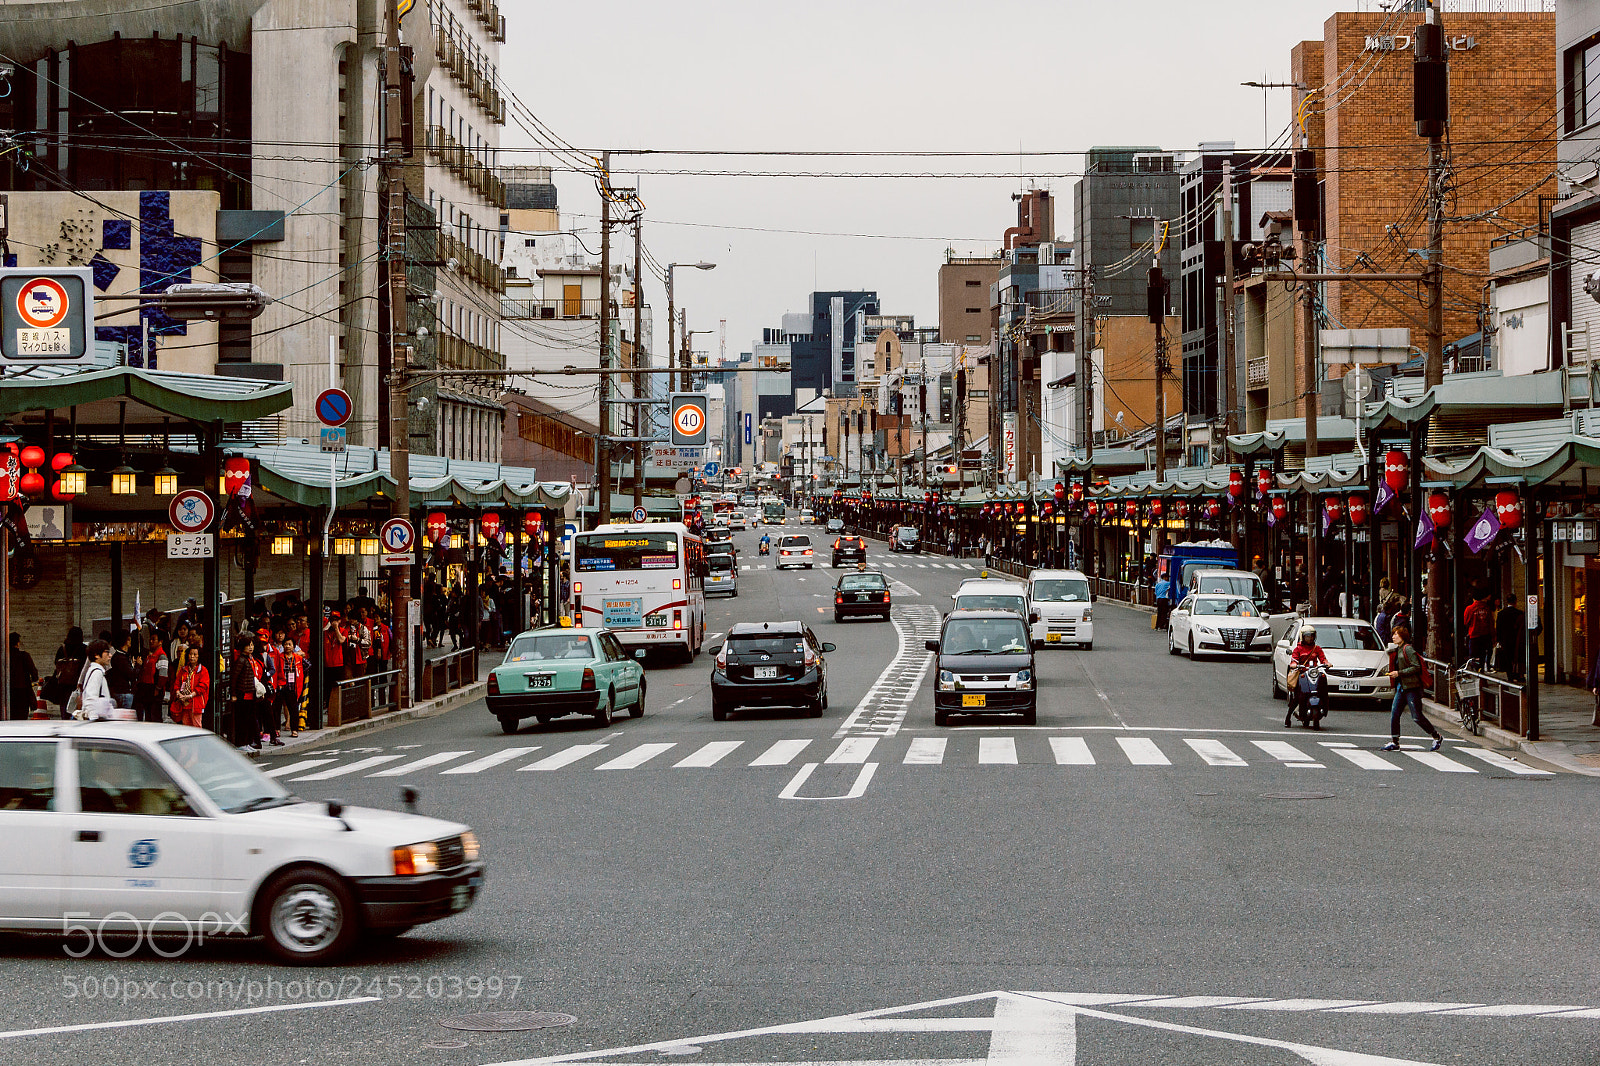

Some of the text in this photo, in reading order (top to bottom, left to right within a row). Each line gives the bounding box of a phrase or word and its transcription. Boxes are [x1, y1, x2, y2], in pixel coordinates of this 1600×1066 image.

[681, 413, 699, 427] 40
[1006, 430, 1014, 471] カラオケ
[170, 547, 212, 555] ここから
